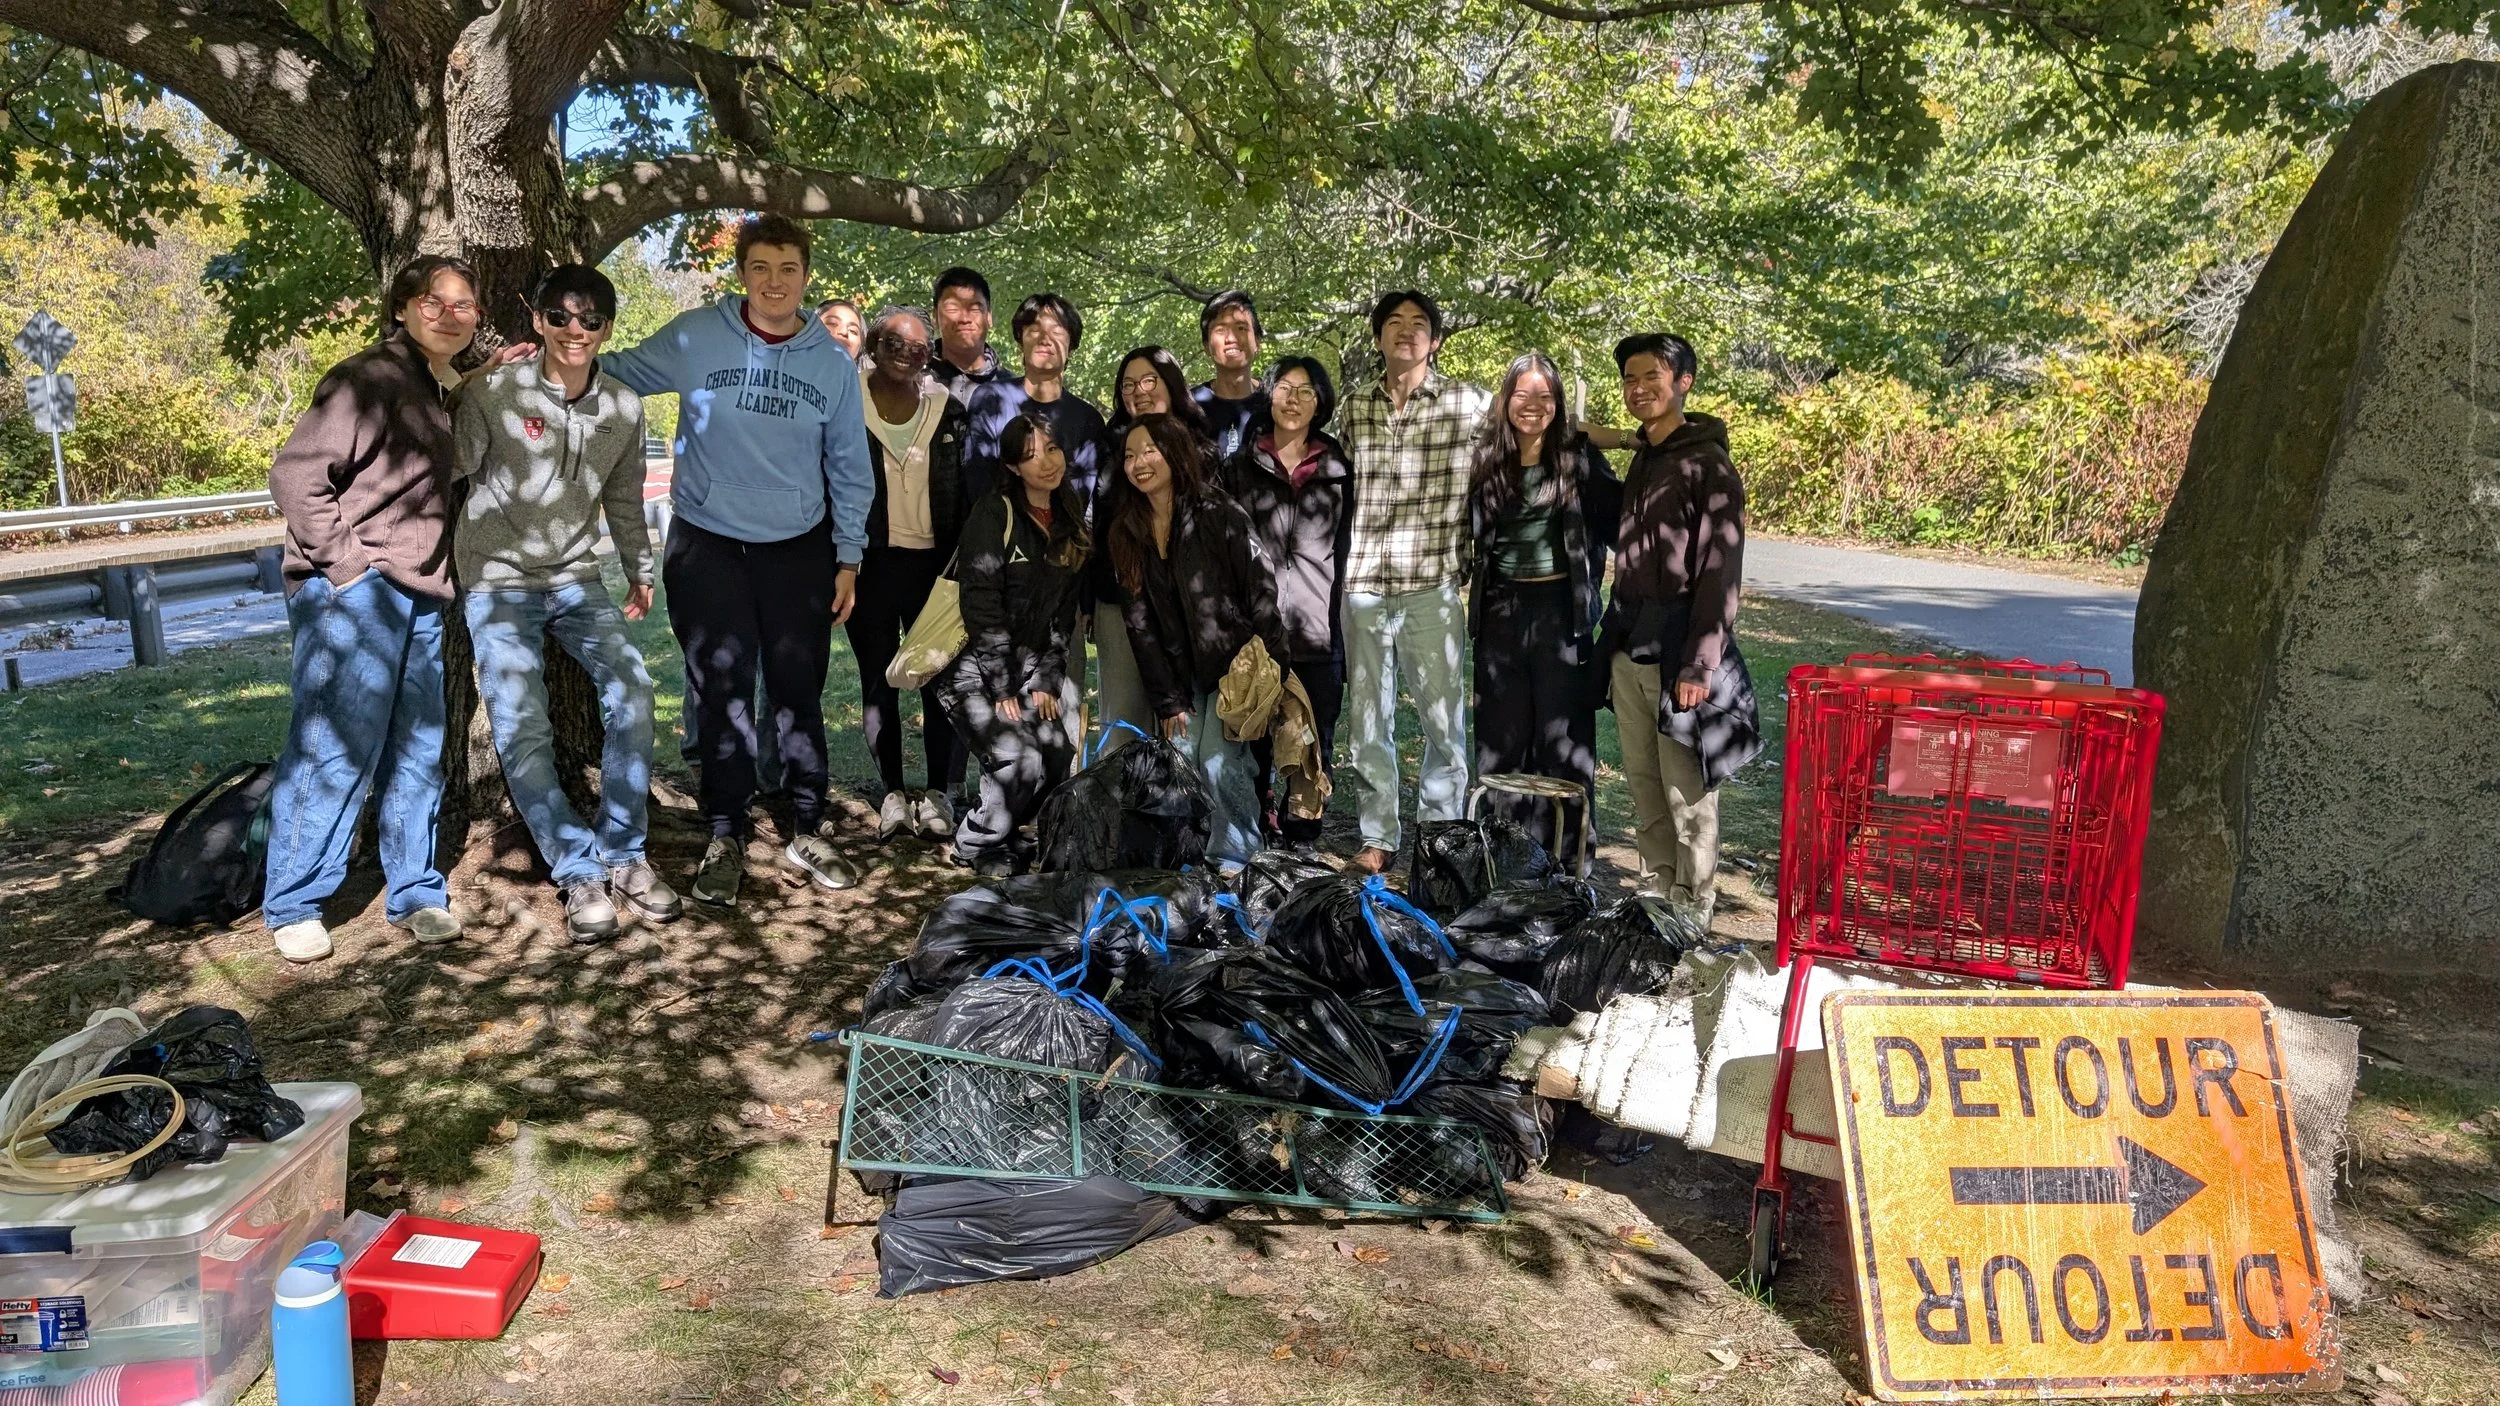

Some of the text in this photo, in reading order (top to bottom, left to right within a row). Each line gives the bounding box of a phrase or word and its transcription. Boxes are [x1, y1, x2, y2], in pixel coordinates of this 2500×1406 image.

[705, 367, 827, 416] CHRISTIAN BROTHERS
[736, 390, 798, 420] ACADEMY
[1874, 1035, 2249, 1119] DETOUR
[3, 1302, 30, 1310] Hefty
[1907, 1253, 2294, 1345] DETOUR
[18, 1374, 46, 1385] Free
